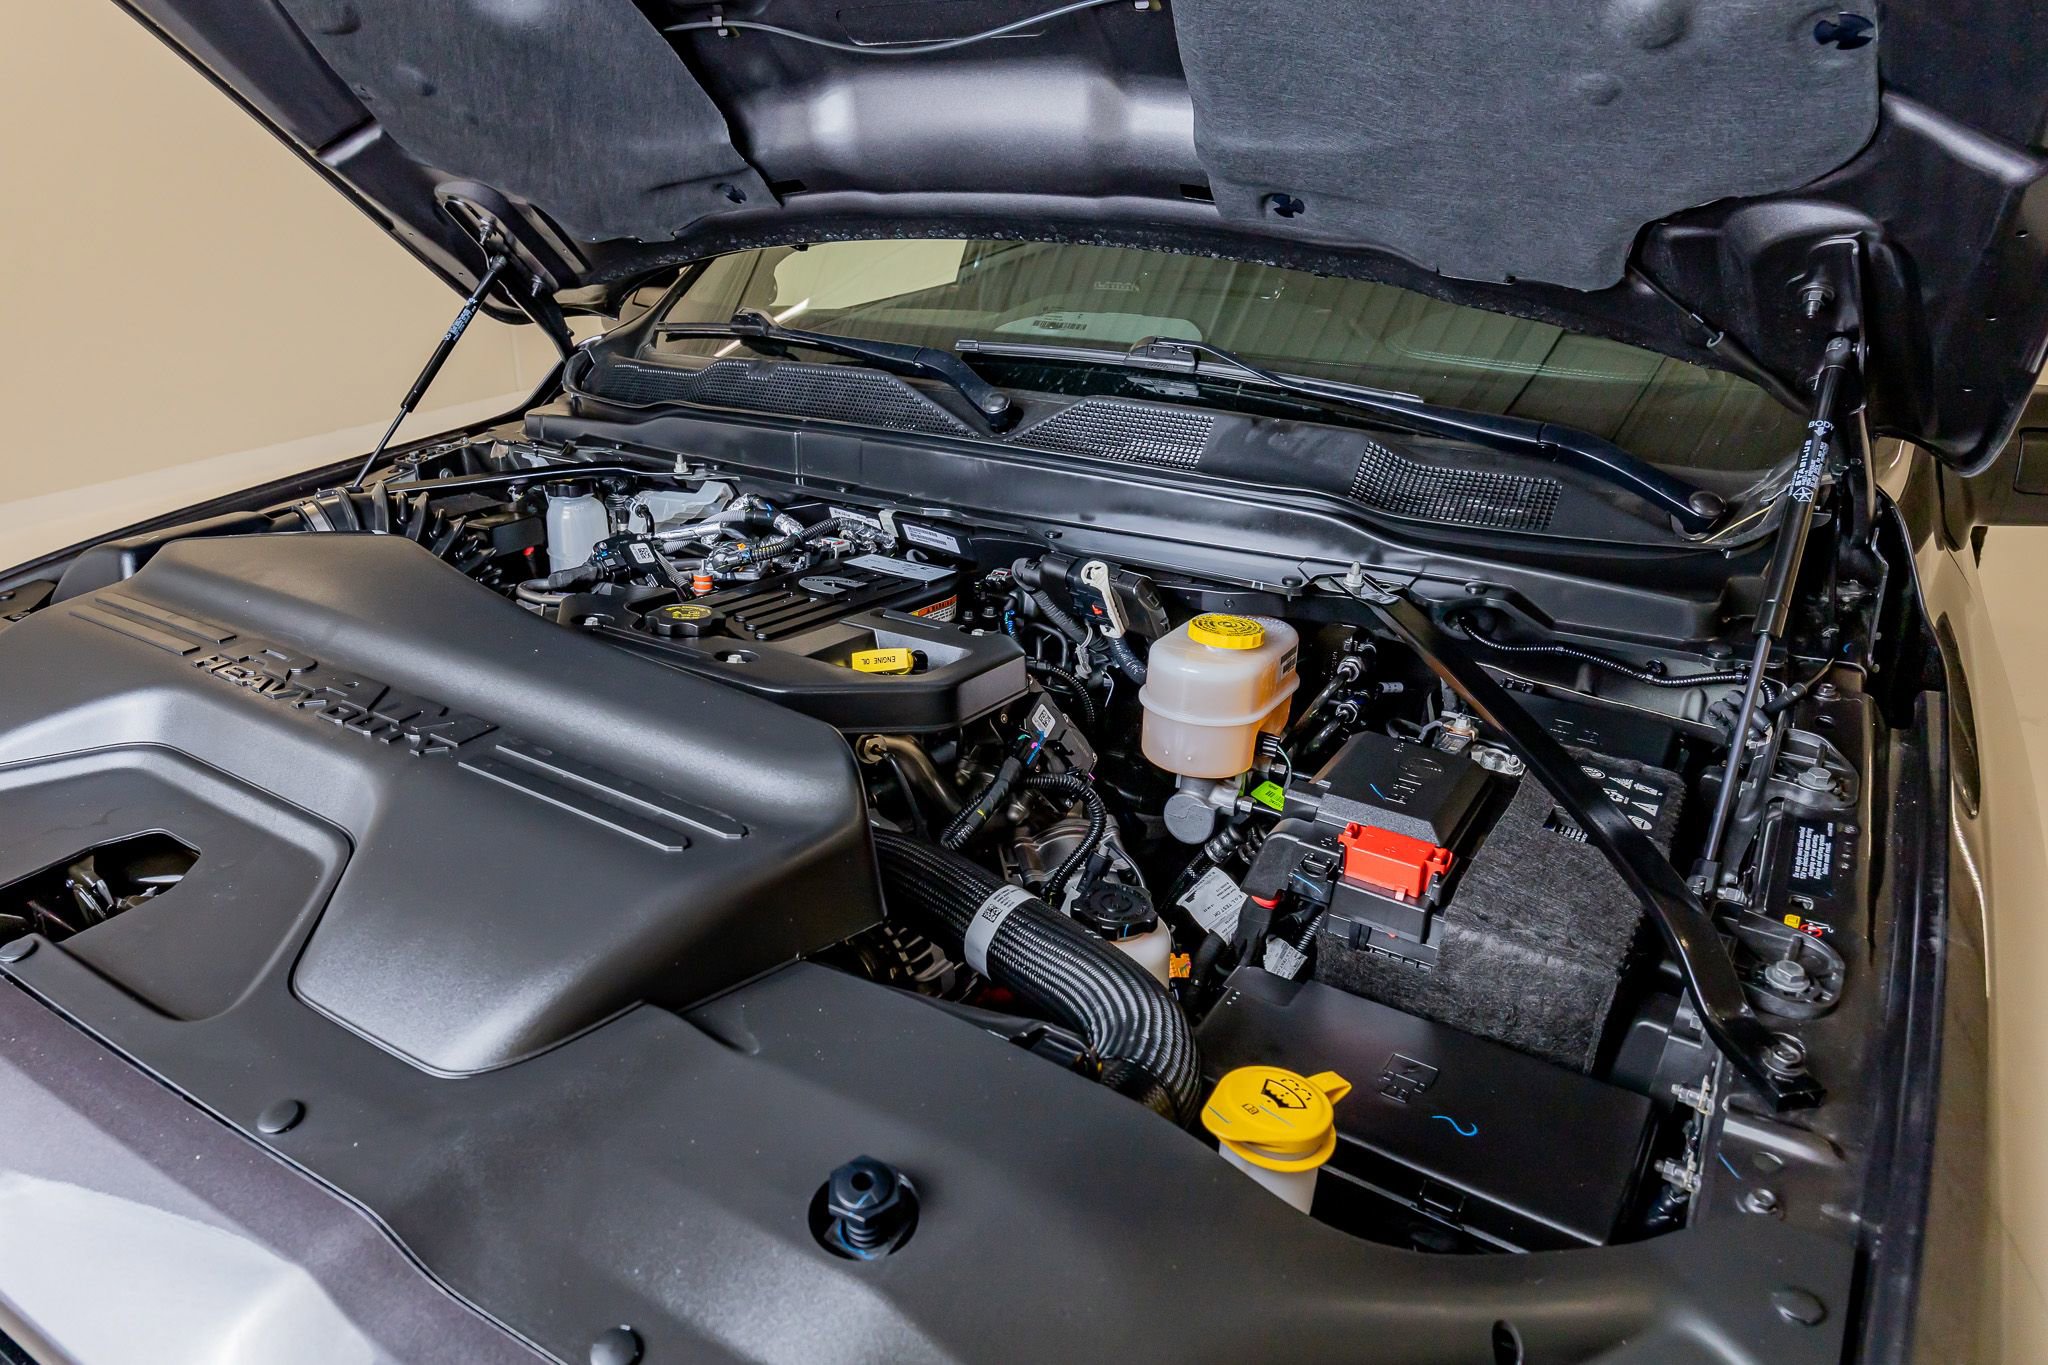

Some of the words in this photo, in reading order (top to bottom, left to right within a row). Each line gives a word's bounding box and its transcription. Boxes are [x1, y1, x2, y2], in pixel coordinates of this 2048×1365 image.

[1808, 419, 1835, 430] BODY
[1795, 440, 1812, 487] STABILUS
[873, 655, 896, 665] ENGINE
[191, 654, 328, 709] HEAVY
[316, 700, 450, 756] DUTY
[219, 639, 500, 746] RAM
[1220, 902, 1232, 913] TEST
